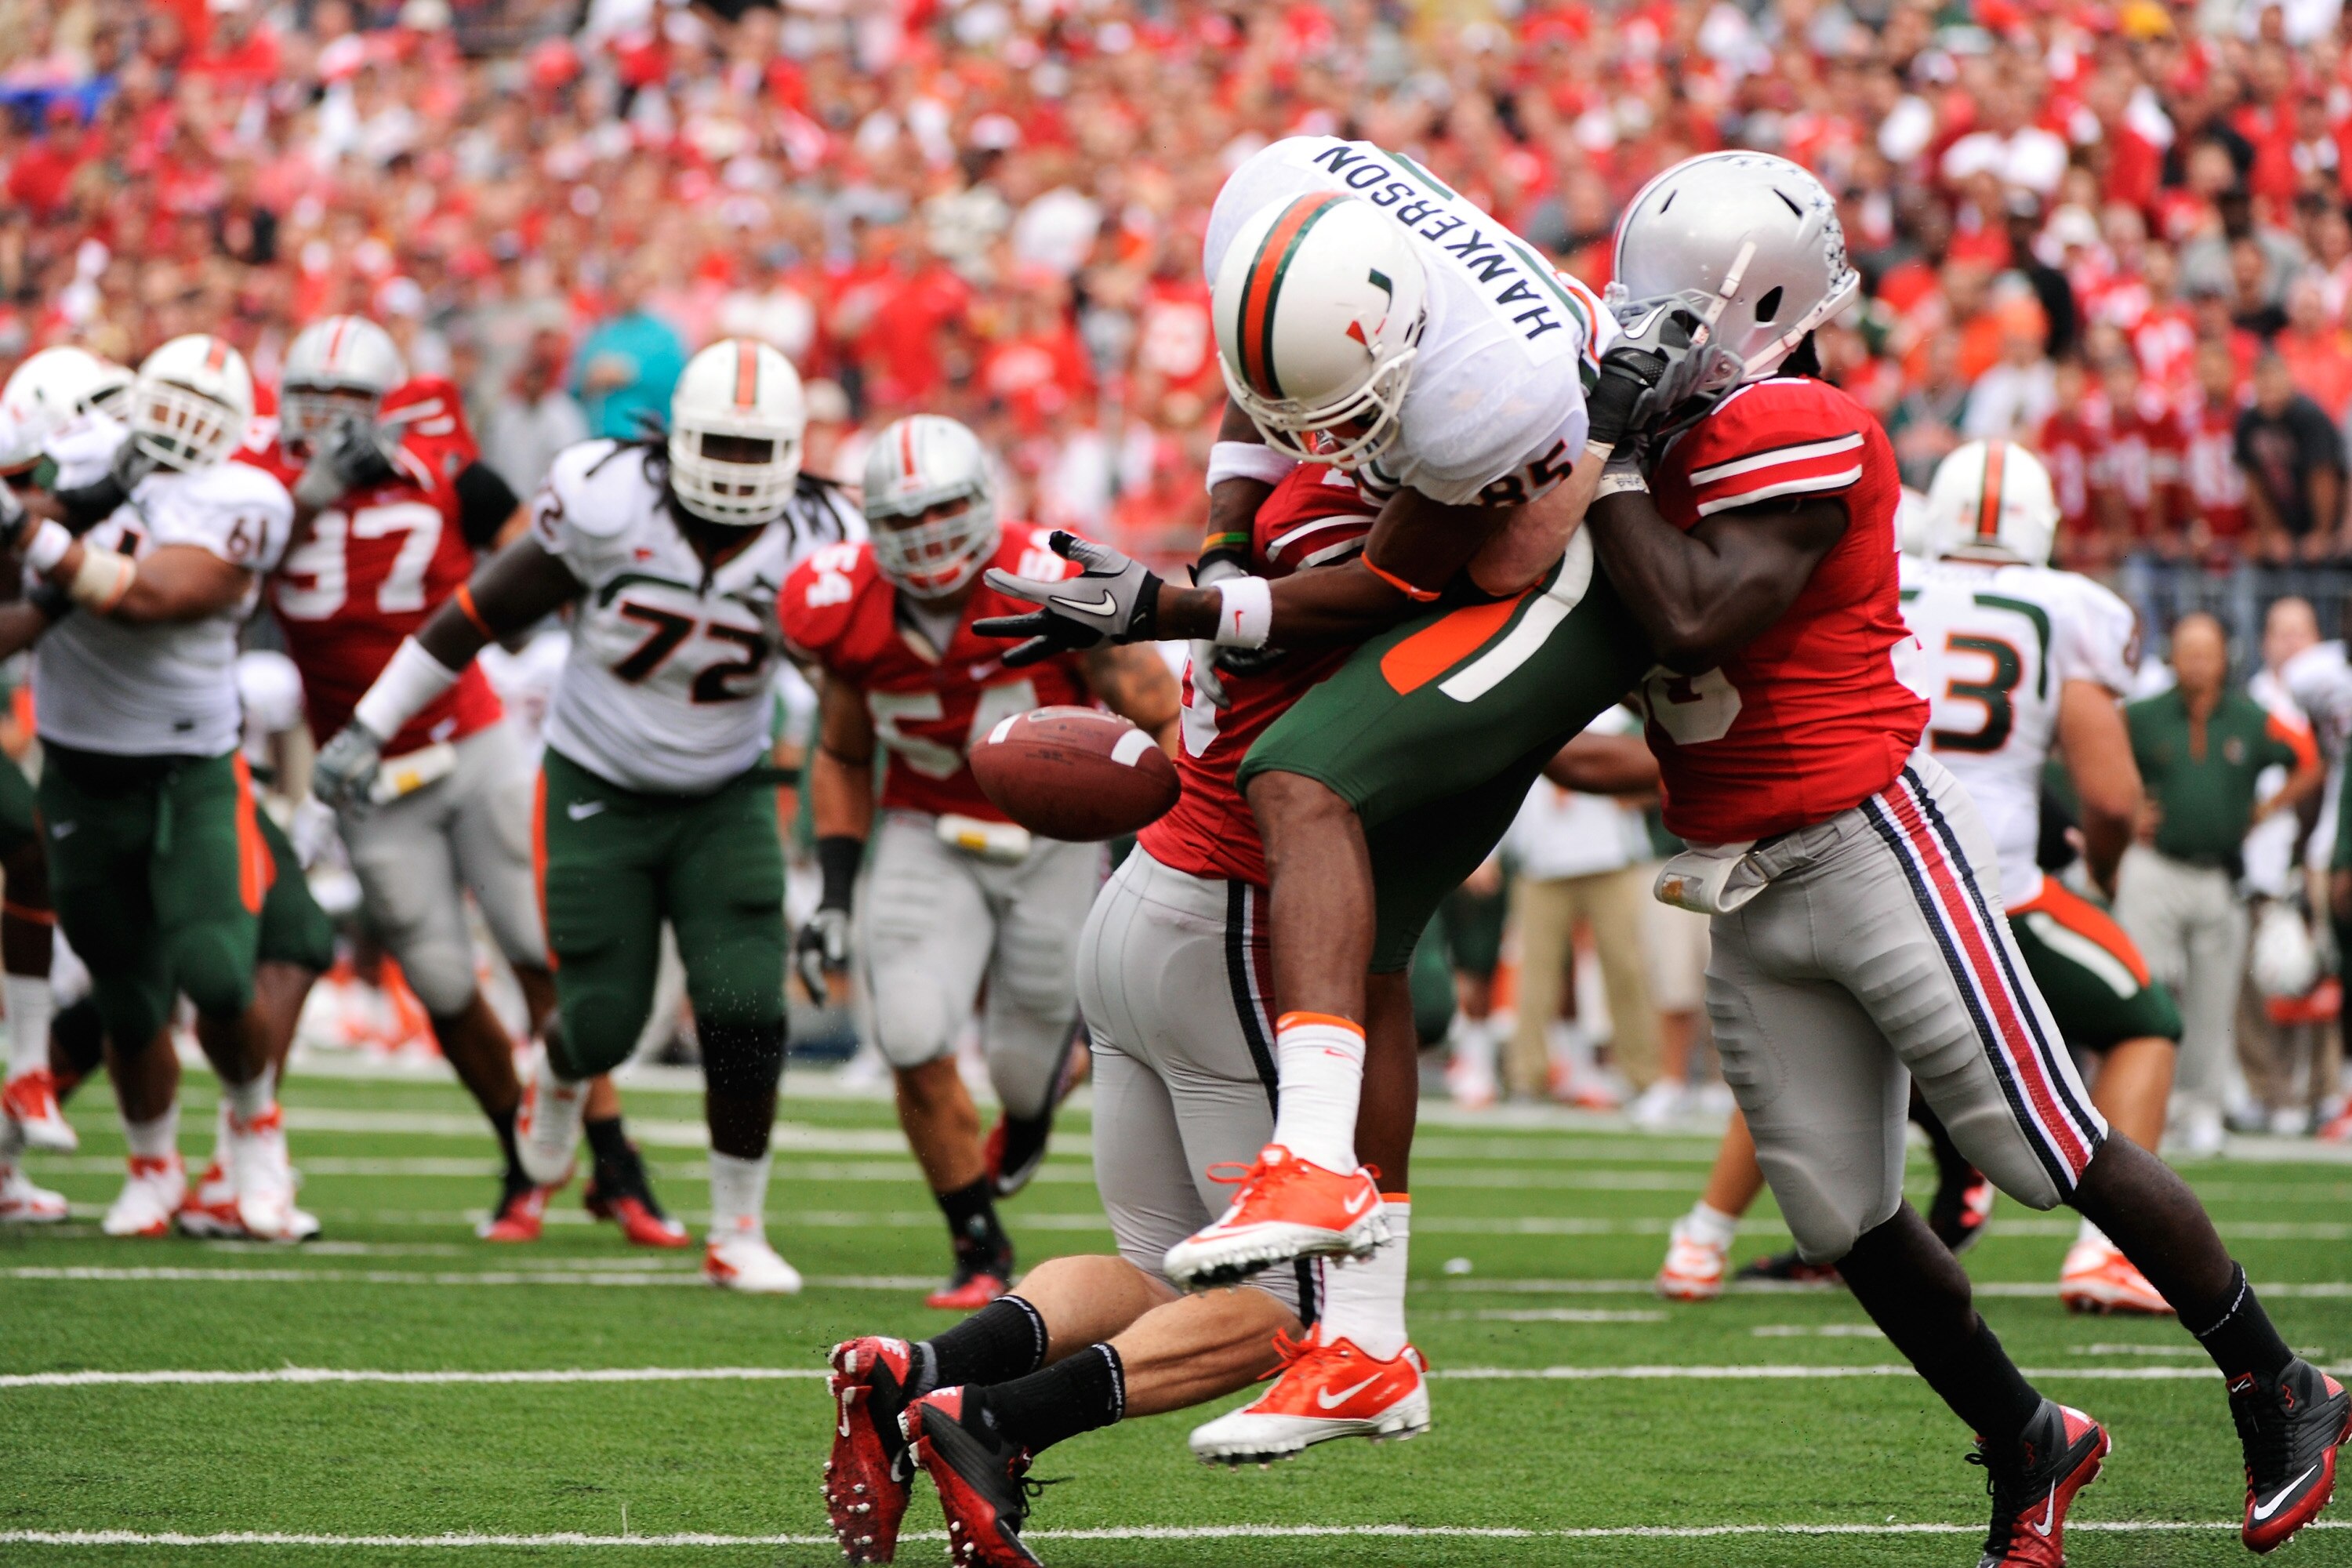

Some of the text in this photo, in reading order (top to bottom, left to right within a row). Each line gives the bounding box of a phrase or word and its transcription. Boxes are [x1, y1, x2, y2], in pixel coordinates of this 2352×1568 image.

[1312, 146, 1563, 340] HANKERSON
[227, 517, 269, 558] 61
[278, 501, 444, 622] 97
[805, 543, 860, 609] 54
[610, 600, 768, 703] 72
[1931, 631, 2024, 753] 3
